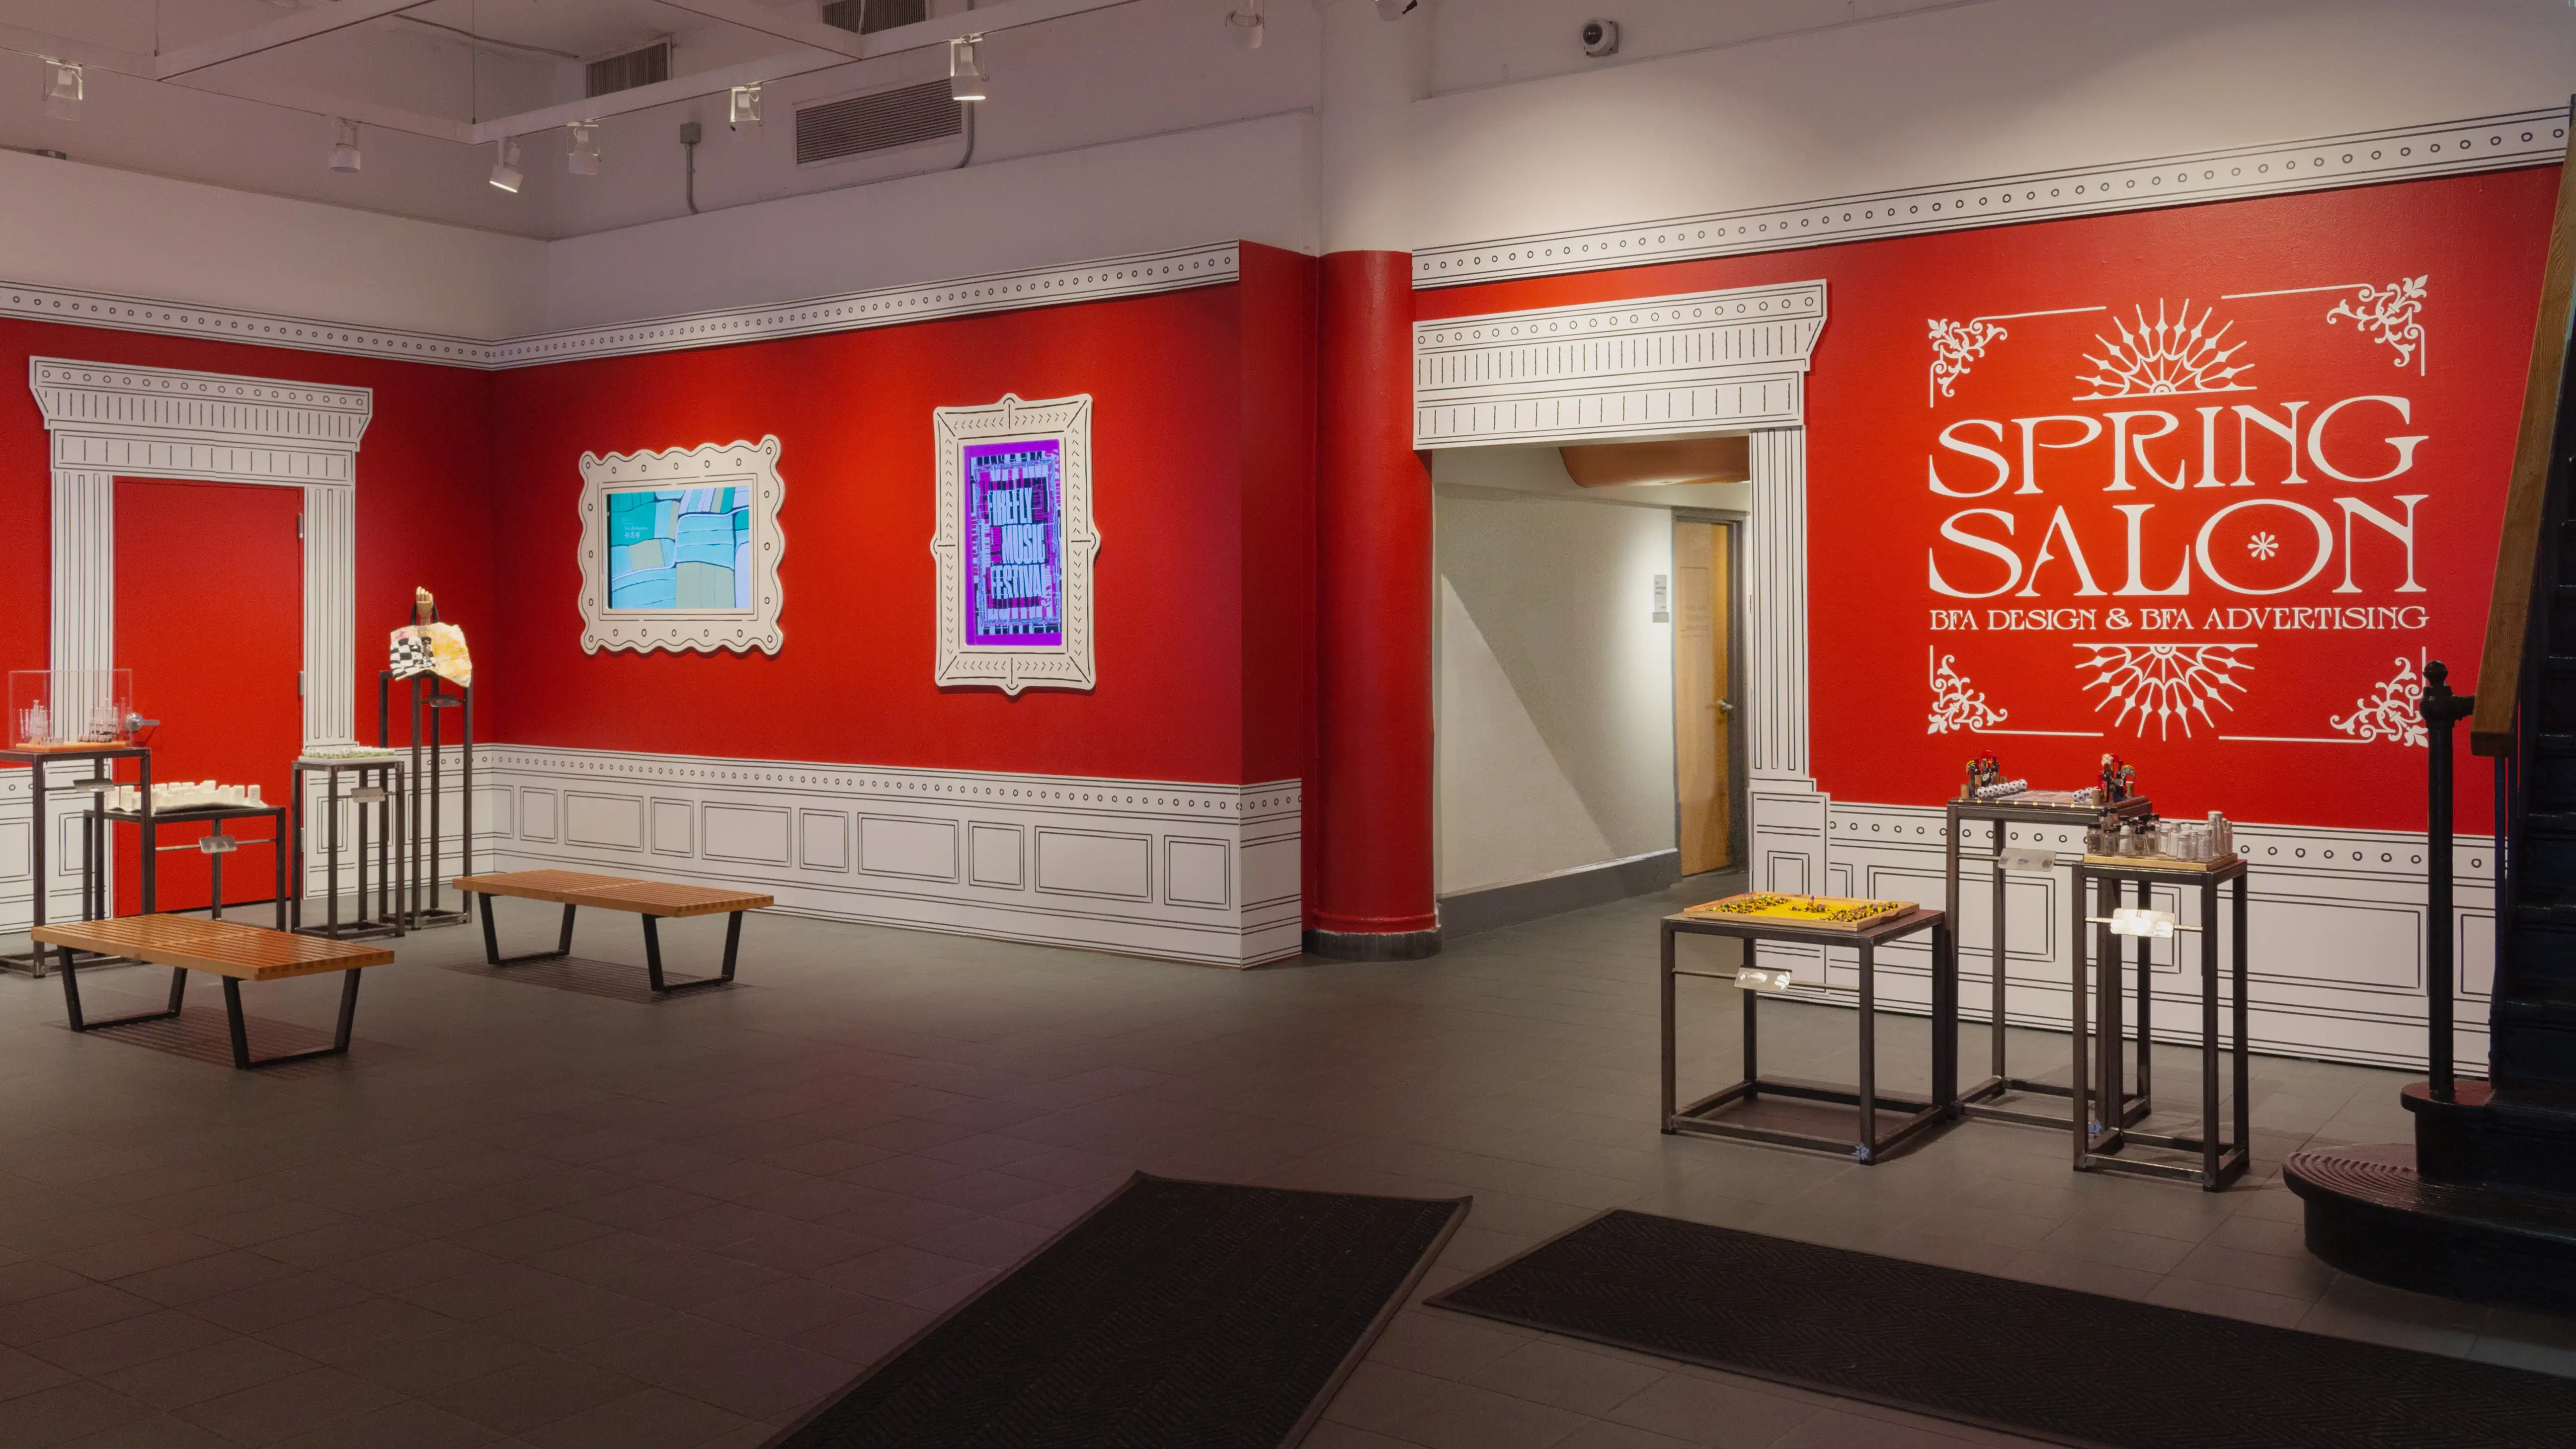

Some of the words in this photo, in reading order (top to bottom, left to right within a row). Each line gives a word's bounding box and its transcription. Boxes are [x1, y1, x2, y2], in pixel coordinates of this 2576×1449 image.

[1930, 396, 2428, 497] SPRING
[988, 487, 1032, 526] FIREFLY
[1001, 522, 1046, 564] MUSIC
[1930, 495, 2428, 598] SALON
[1930, 610, 1978, 630] BFA
[1988, 609, 2096, 630] DESIGN
[2106, 608, 2132, 630] &
[2140, 608, 2194, 630] BFA
[2203, 606, 2429, 629] ADVERTISING
